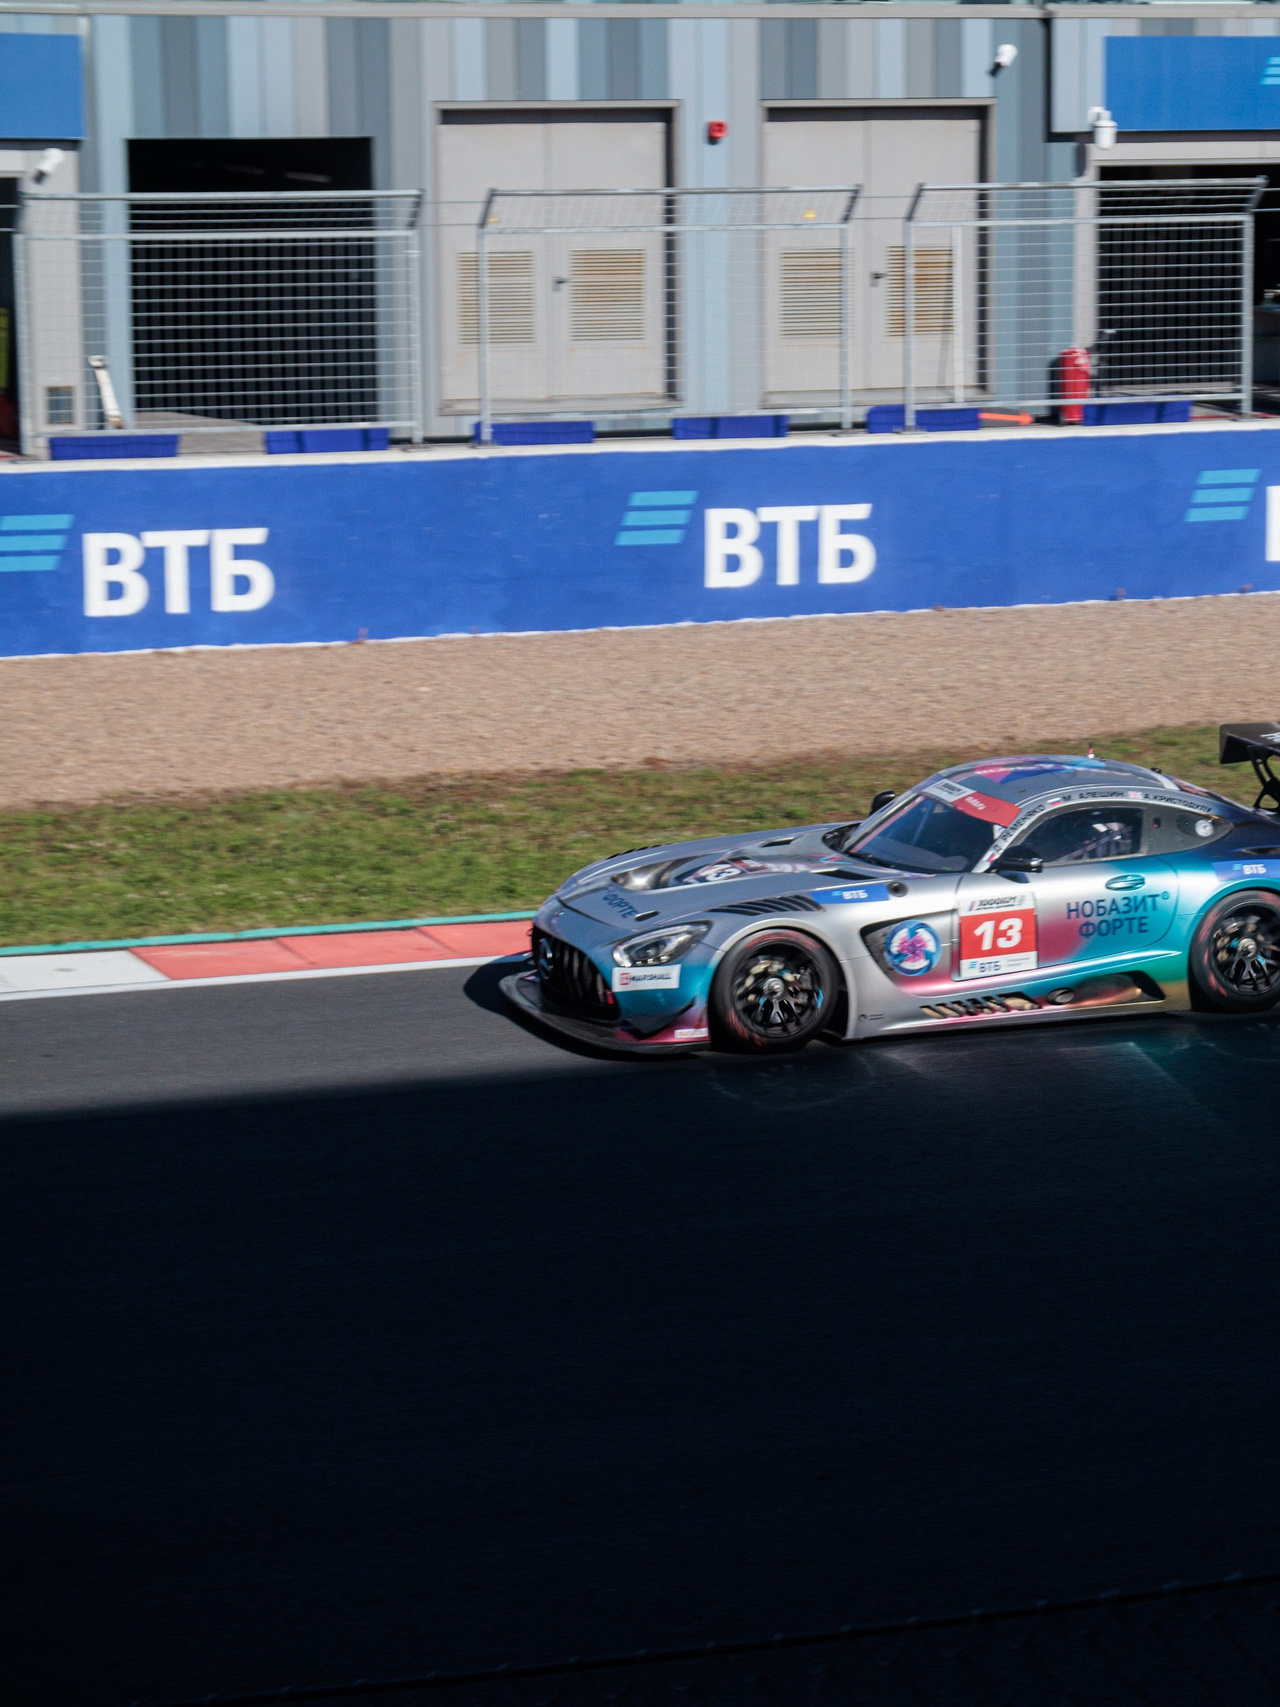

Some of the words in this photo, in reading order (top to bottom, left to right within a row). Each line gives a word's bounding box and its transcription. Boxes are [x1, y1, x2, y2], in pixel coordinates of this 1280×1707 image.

[703, 503, 877, 589] ВТБ
[82, 527, 275, 618] ВТБ
[1242, 863, 1267, 875] ВТБ
[842, 889, 869, 900] ВТБ
[973, 917, 1024, 951] 13
[1079, 915, 1150, 939] ФОРТЕ
